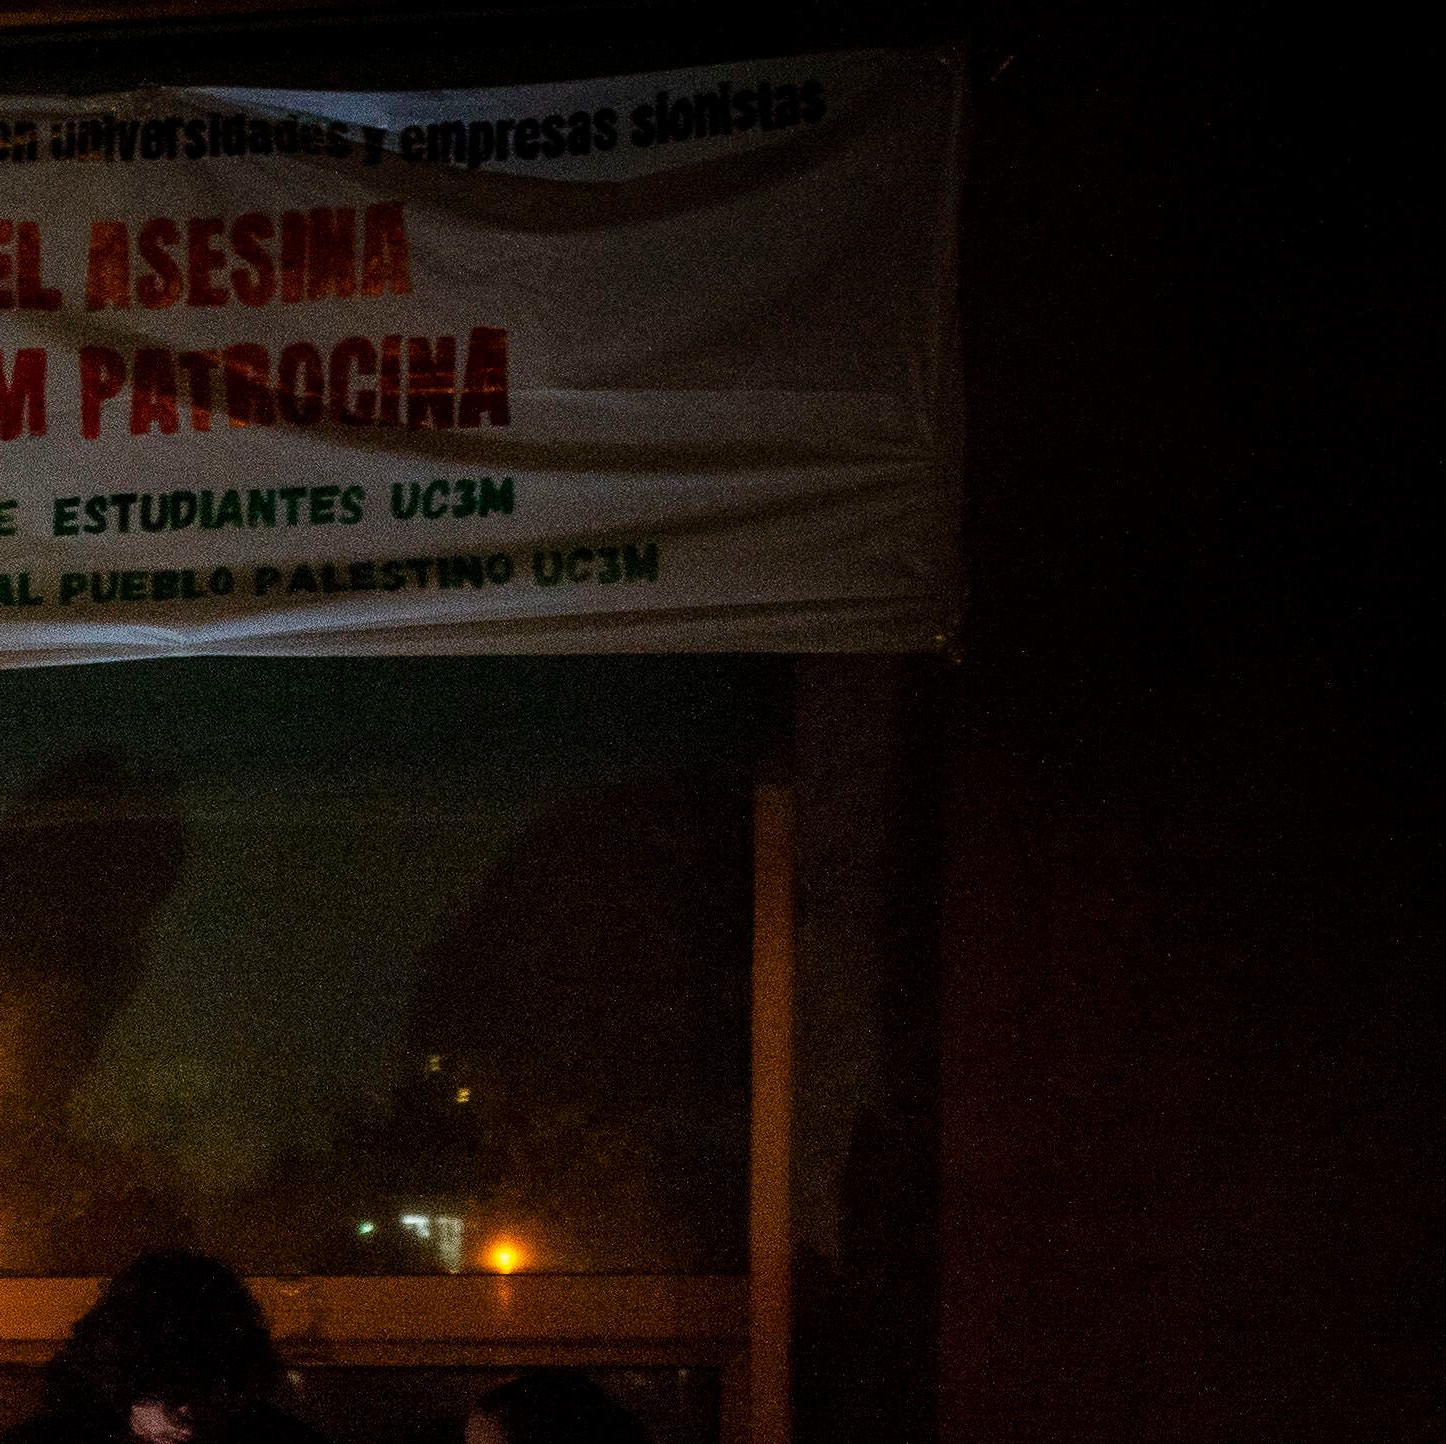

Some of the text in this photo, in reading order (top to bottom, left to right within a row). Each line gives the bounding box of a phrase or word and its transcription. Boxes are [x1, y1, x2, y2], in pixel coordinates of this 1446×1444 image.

[51, 111, 354, 163] universidades
[363, 126, 387, 166] y
[400, 105, 617, 169] empresas
[631, 78, 826, 149] sionistas
[84, 202, 412, 313] ASESINA
[79, 326, 510, 441] PATROCINA
[52, 484, 366, 537] ESTUDIANTES
[389, 476, 516, 521] UC3M
[58, 565, 235, 606] PUEBLO
[253, 551, 516, 596] PALESTINO
[532, 542, 661, 587] UC3M
